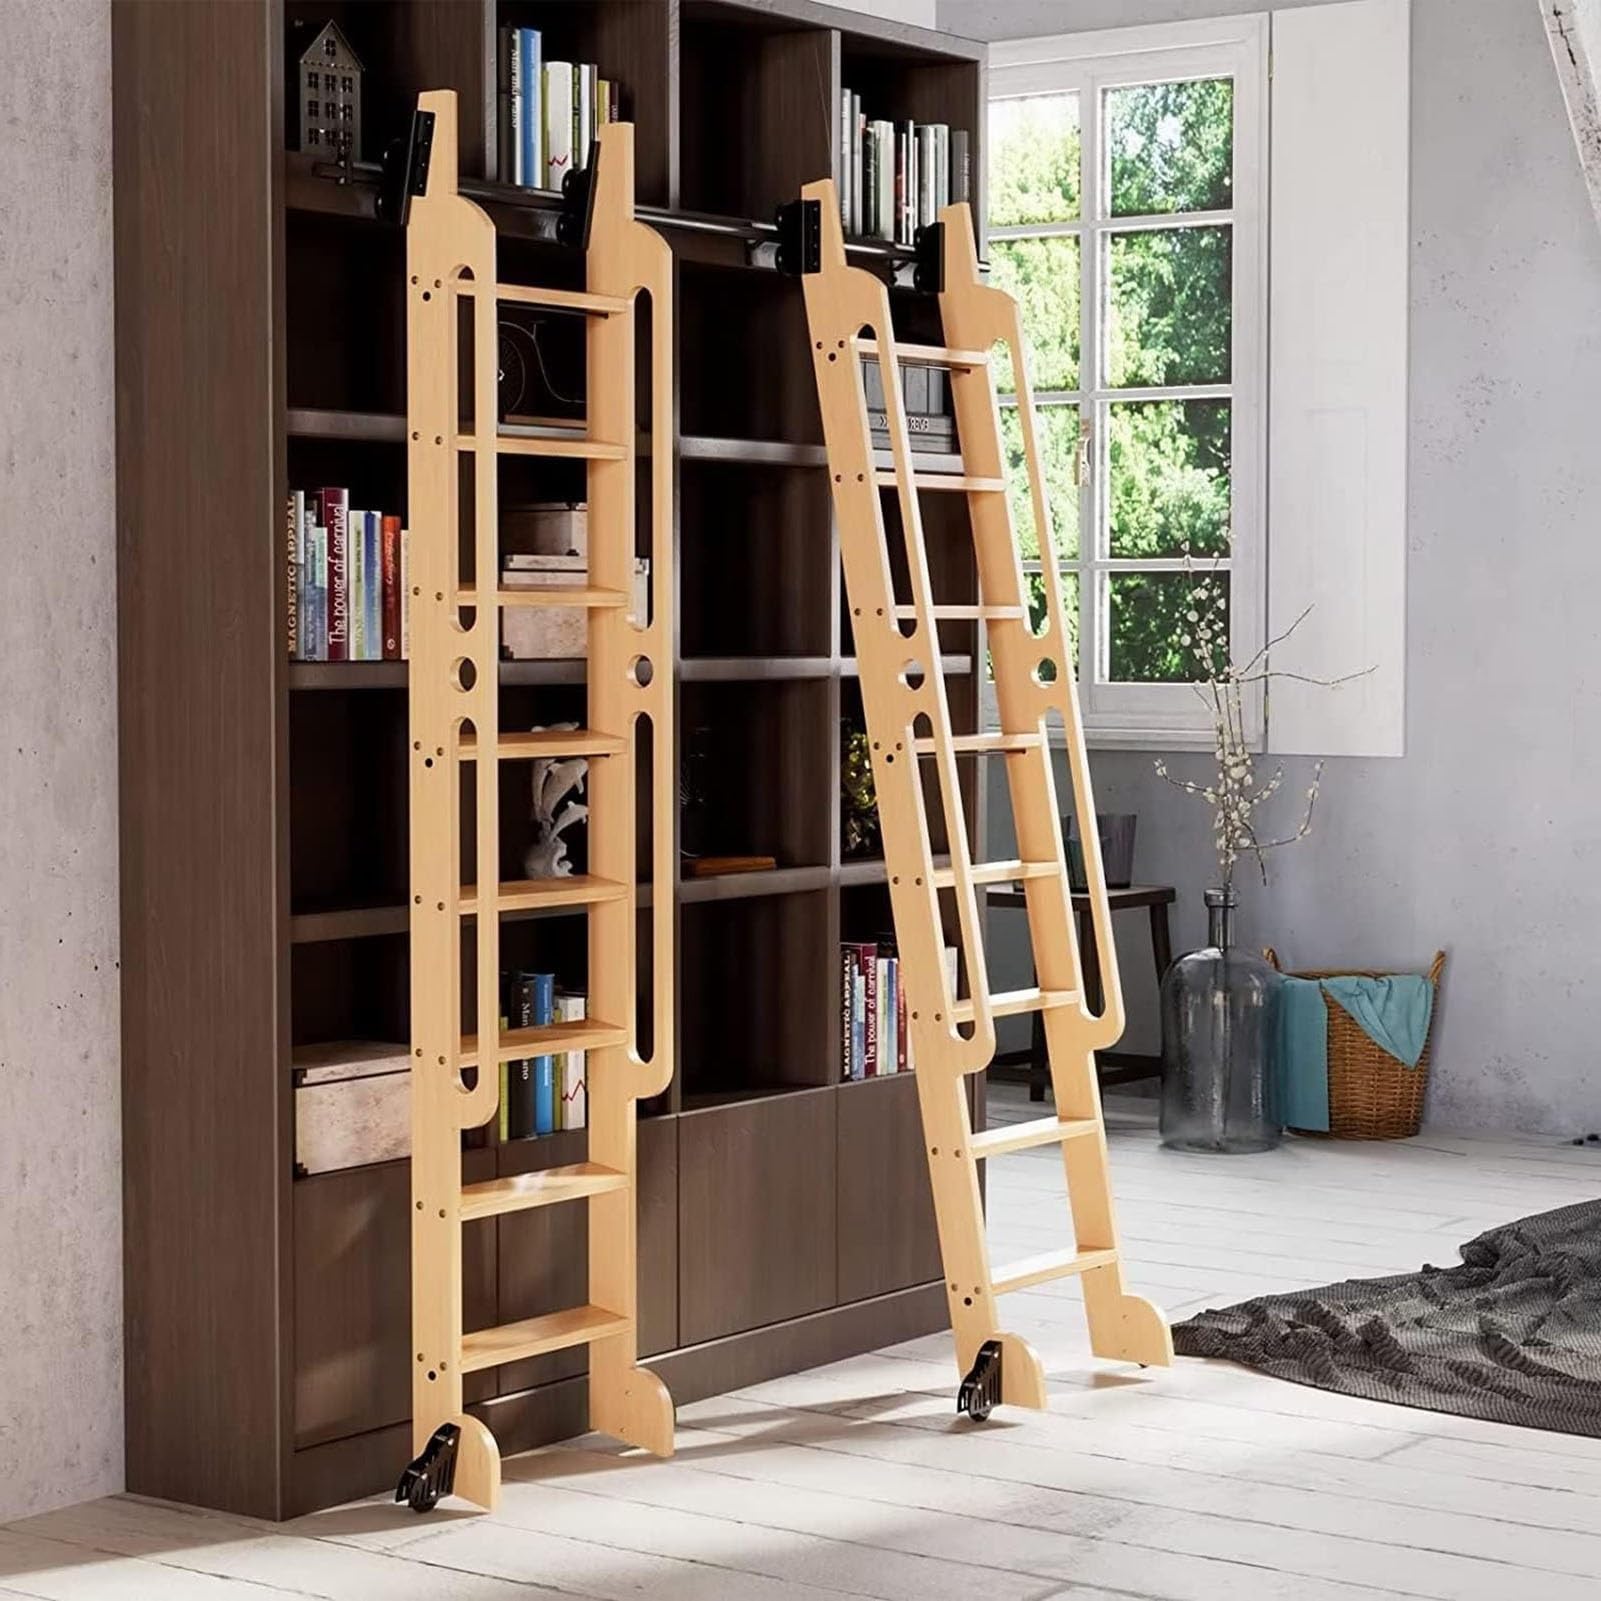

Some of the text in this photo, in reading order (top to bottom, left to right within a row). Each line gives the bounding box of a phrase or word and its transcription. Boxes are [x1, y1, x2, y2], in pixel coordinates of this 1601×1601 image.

[287, 495, 297, 652] MAGNETIC APPEAL
[328, 503, 348, 645] The power of carnival
[522, 1003, 530, 1026] Man
[865, 955, 877, 1065] The power of carnival
